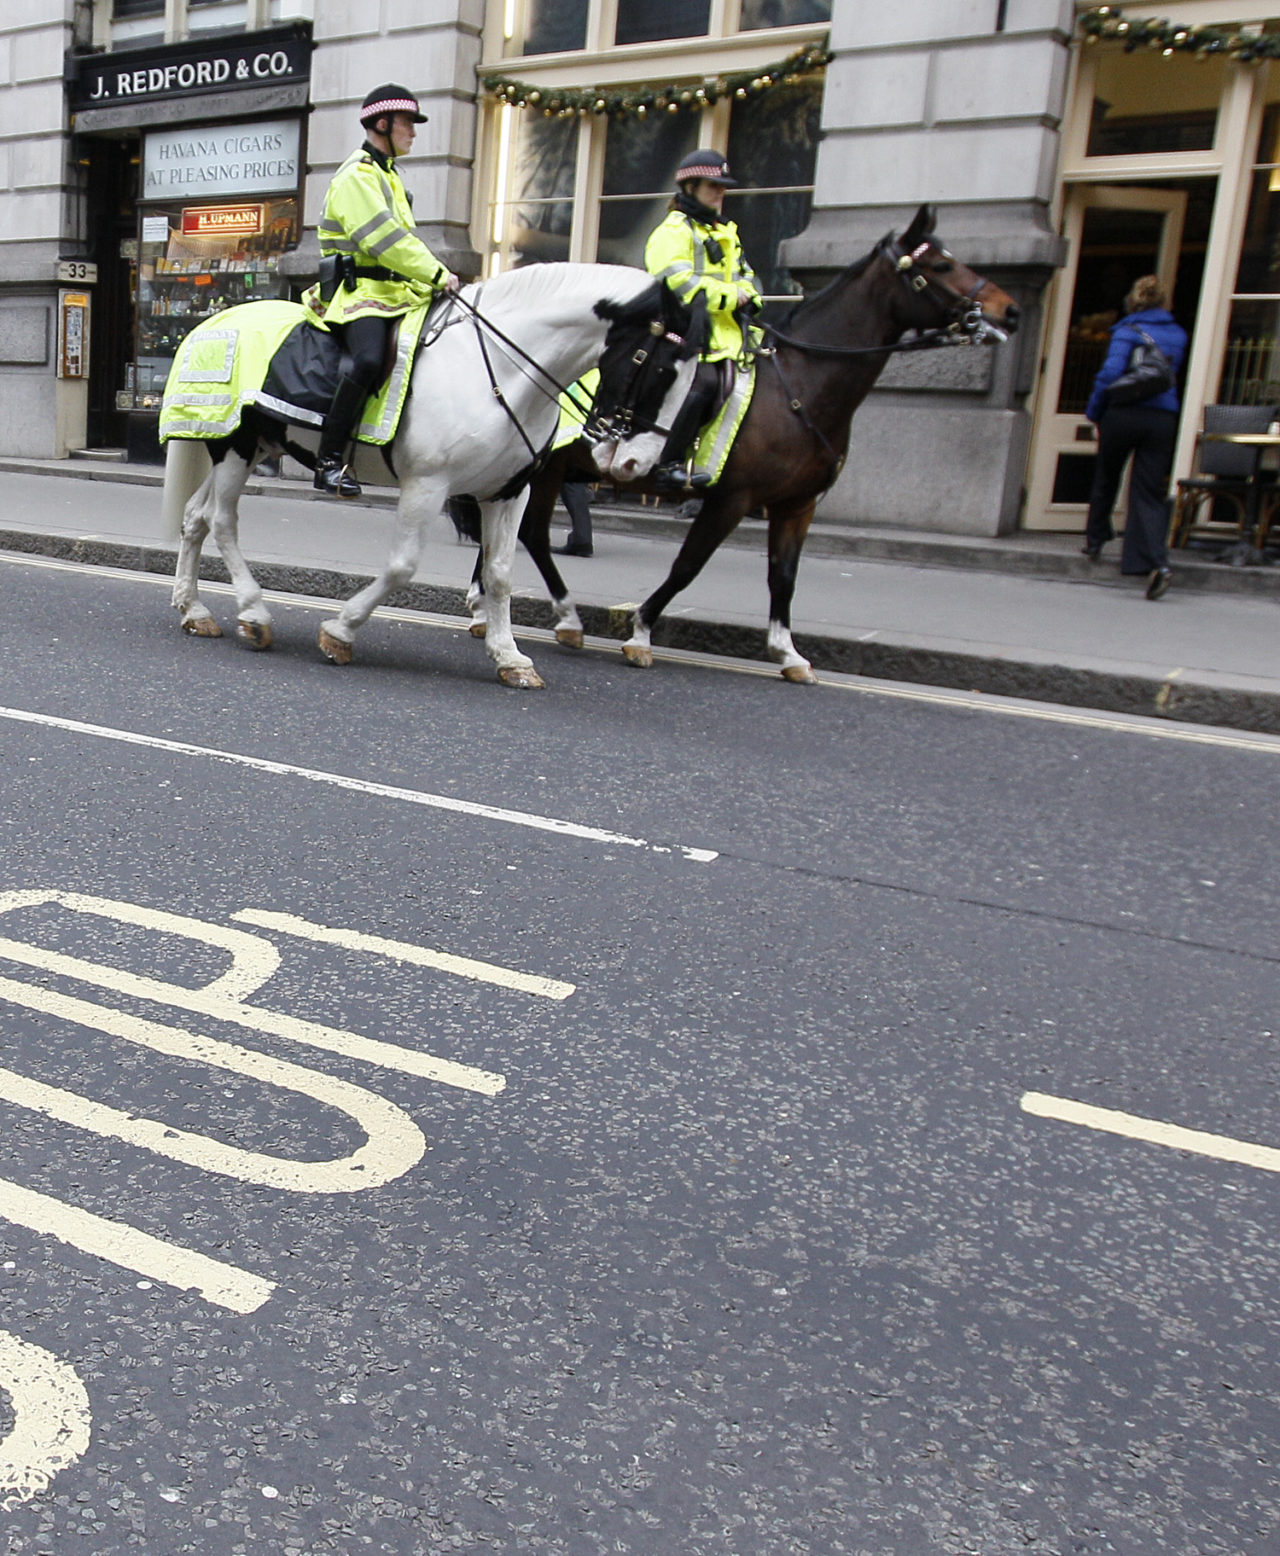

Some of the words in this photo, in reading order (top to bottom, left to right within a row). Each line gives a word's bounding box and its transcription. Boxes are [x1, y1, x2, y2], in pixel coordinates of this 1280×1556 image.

[90, 76, 110, 99] J.
[117, 58, 230, 95] REDFORD
[235, 58, 250, 80] &
[253, 51, 293, 77] CO.
[159, 139, 218, 160] HAVANA
[224, 134, 282, 155] CIGARS
[146, 169, 166, 187] AT
[170, 164, 240, 184] PLEASING
[243, 160, 295, 178] PRICES
[68, 263, 87, 278] 33
